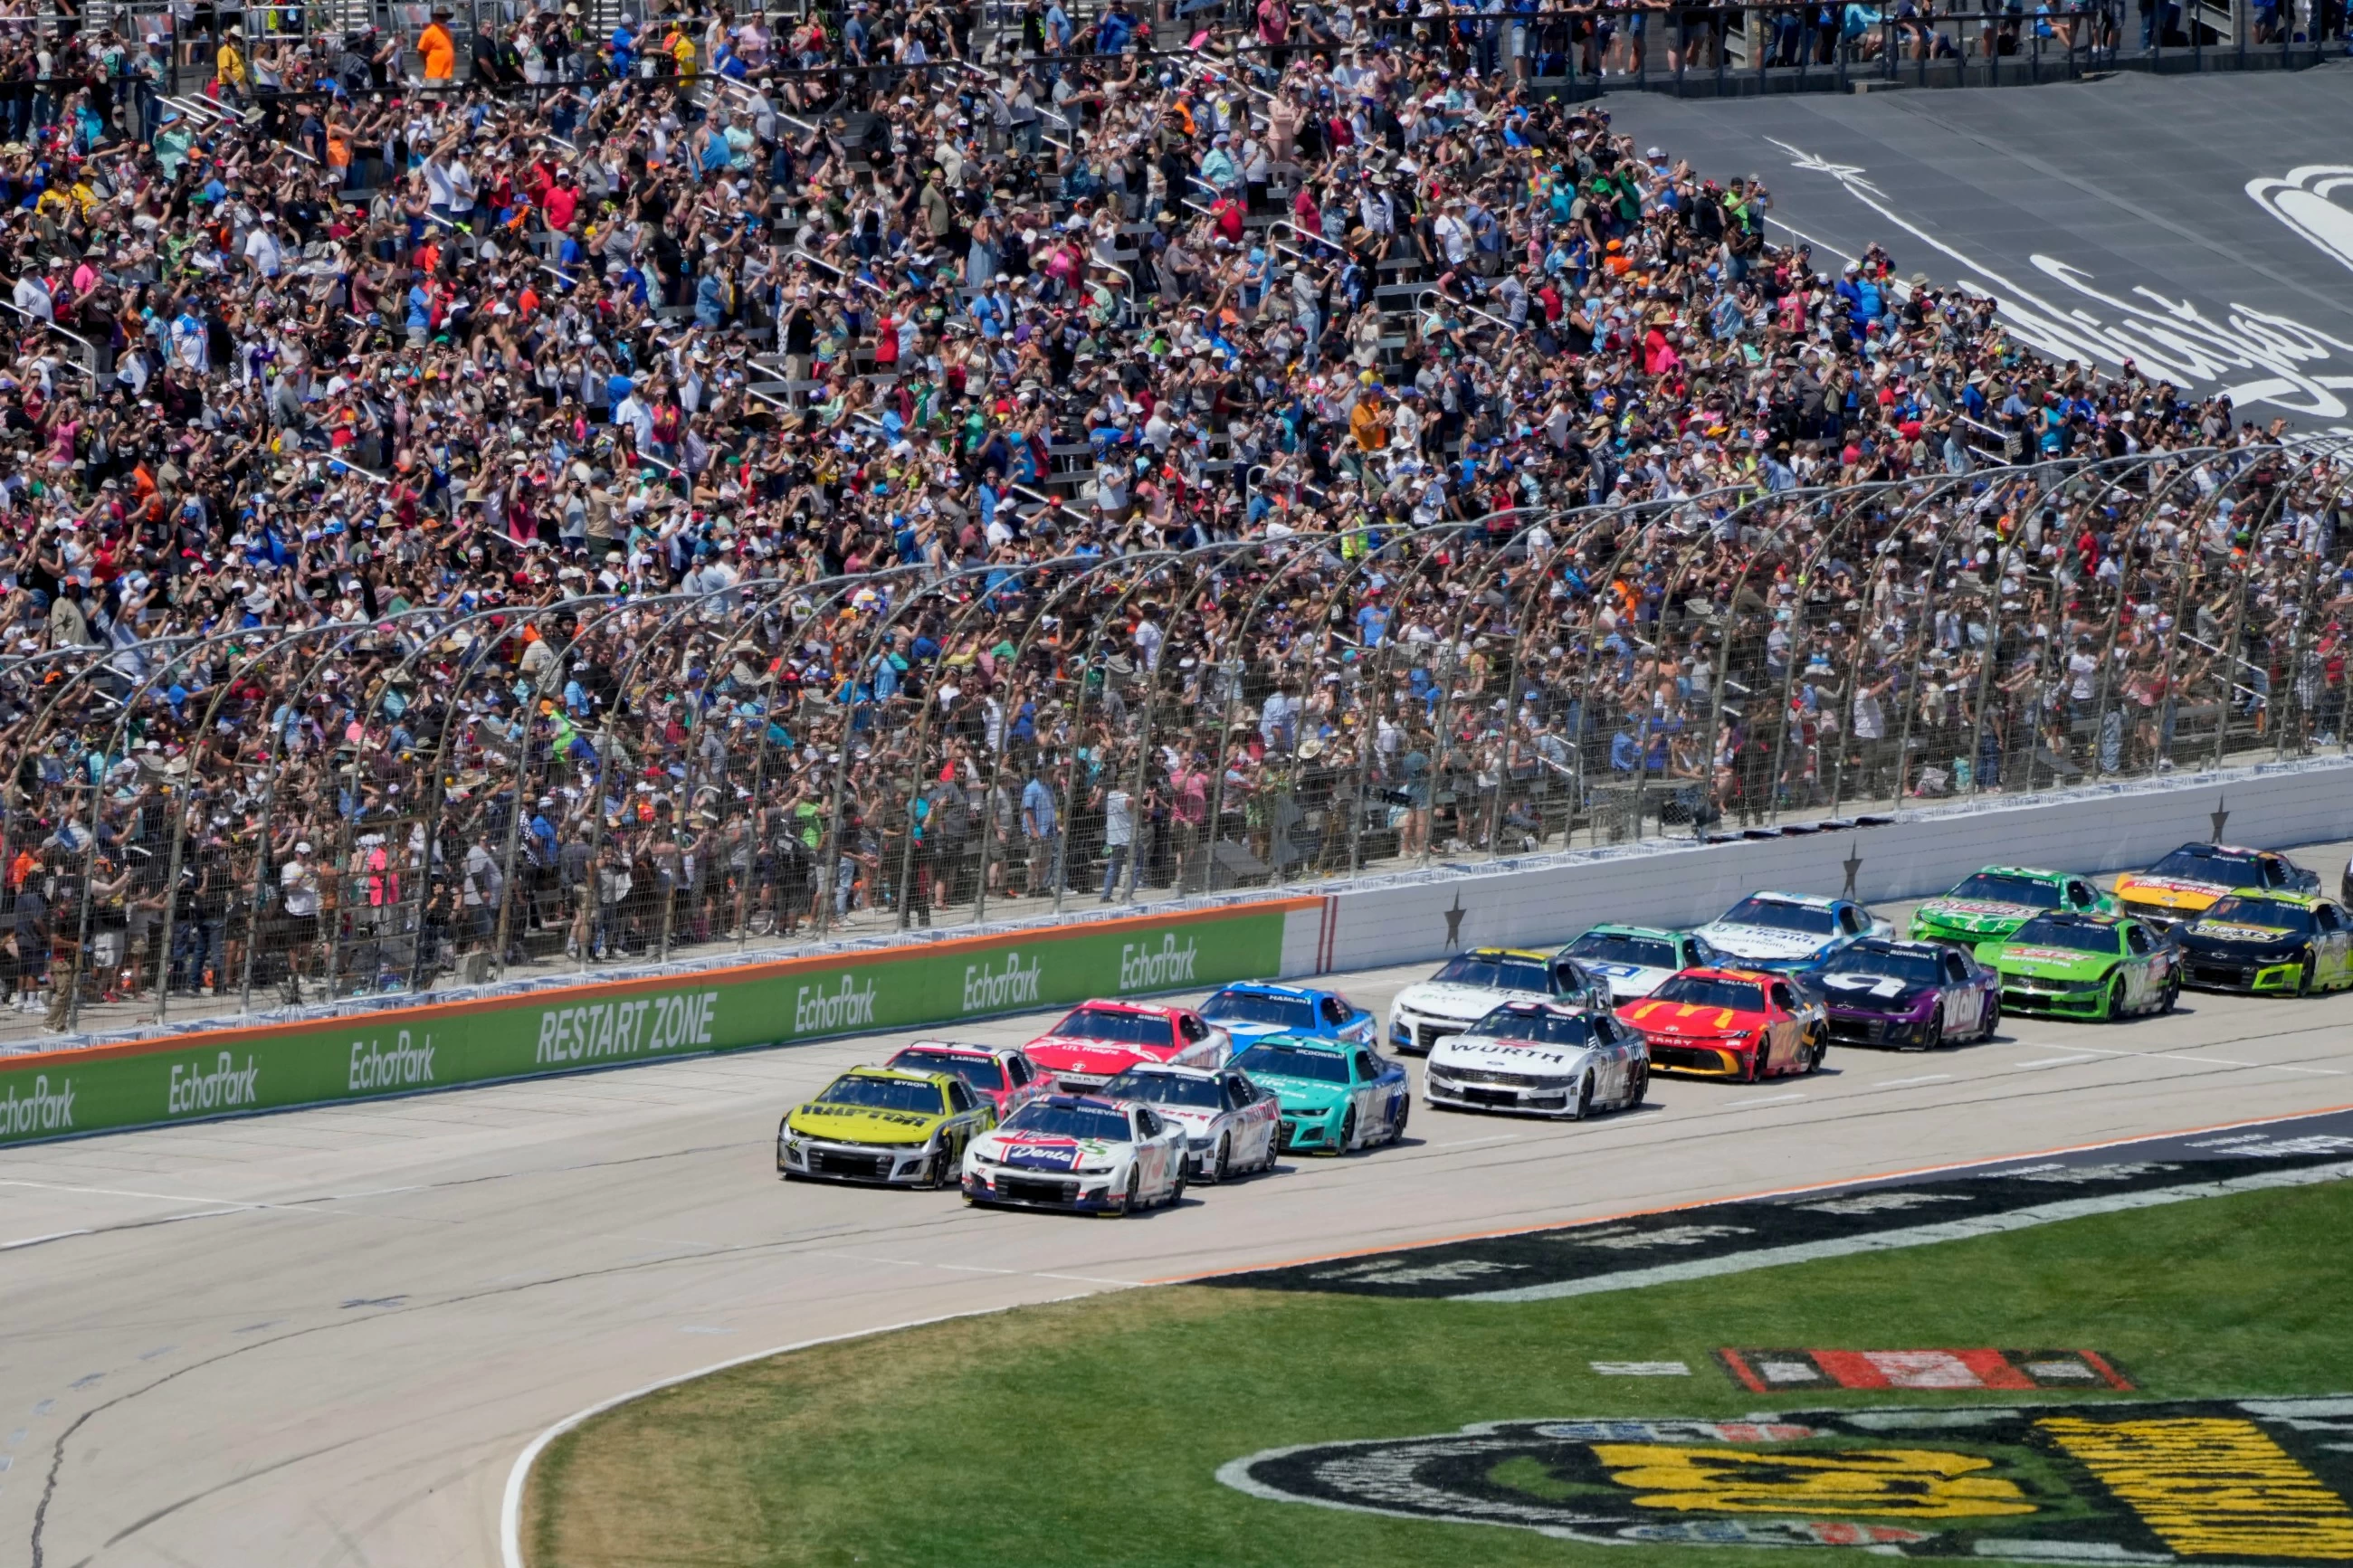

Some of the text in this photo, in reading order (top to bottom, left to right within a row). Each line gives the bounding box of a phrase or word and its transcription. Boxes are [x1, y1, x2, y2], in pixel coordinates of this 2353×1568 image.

[963, 952, 1042, 1011] EchoPark
[1120, 933, 1198, 990] EchoPark
[537, 993, 719, 1063] RESTART ZONE
[795, 974, 877, 1032] EchoPark
[168, 1050, 259, 1115] EchoPark
[348, 1030, 435, 1091] EchoPark
[893, 1079, 928, 1089] BYRON
[950, 1055, 988, 1064] LARSON
[0, 1075, 75, 1134] choPark
